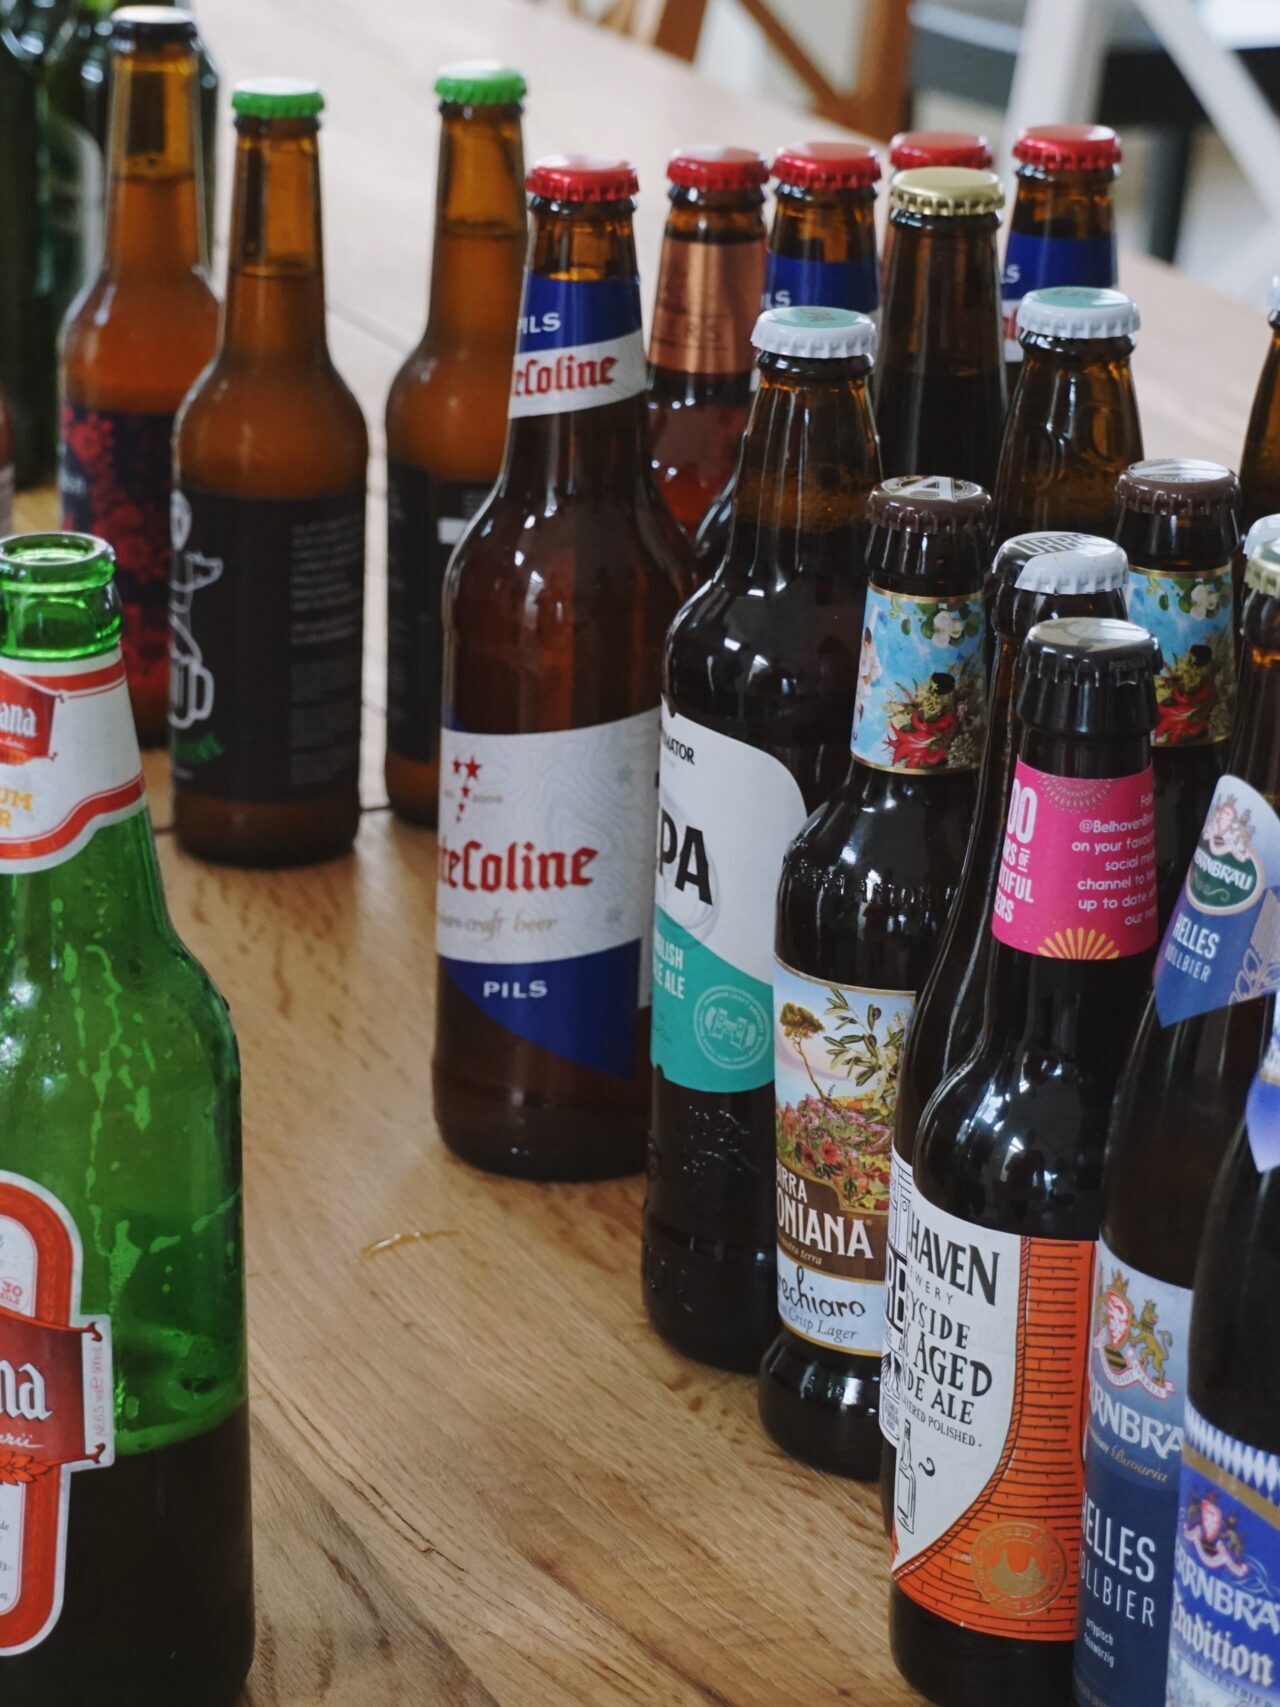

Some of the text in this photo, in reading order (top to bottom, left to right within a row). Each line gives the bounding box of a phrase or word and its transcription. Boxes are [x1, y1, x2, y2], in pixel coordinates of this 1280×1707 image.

[1072, 839, 1090, 852] on
[1094, 832, 1122, 855] your
[1104, 856, 1139, 871] social
[1077, 876, 1131, 891] channel
[1078, 899, 1098, 913] up
[1102, 897, 1118, 909] to
[1121, 891, 1147, 908] date
[1124, 911, 1143, 926] our
[1171, 912, 1220, 960] HELLES
[483, 980, 548, 998] PILS
[664, 967, 685, 1000] ALE
[816, 1319, 858, 1344] Lager
[913, 1331, 993, 1398] AGED
[930, 1388, 975, 1426] ALE
[1080, 1486, 1156, 1583] HELLES
